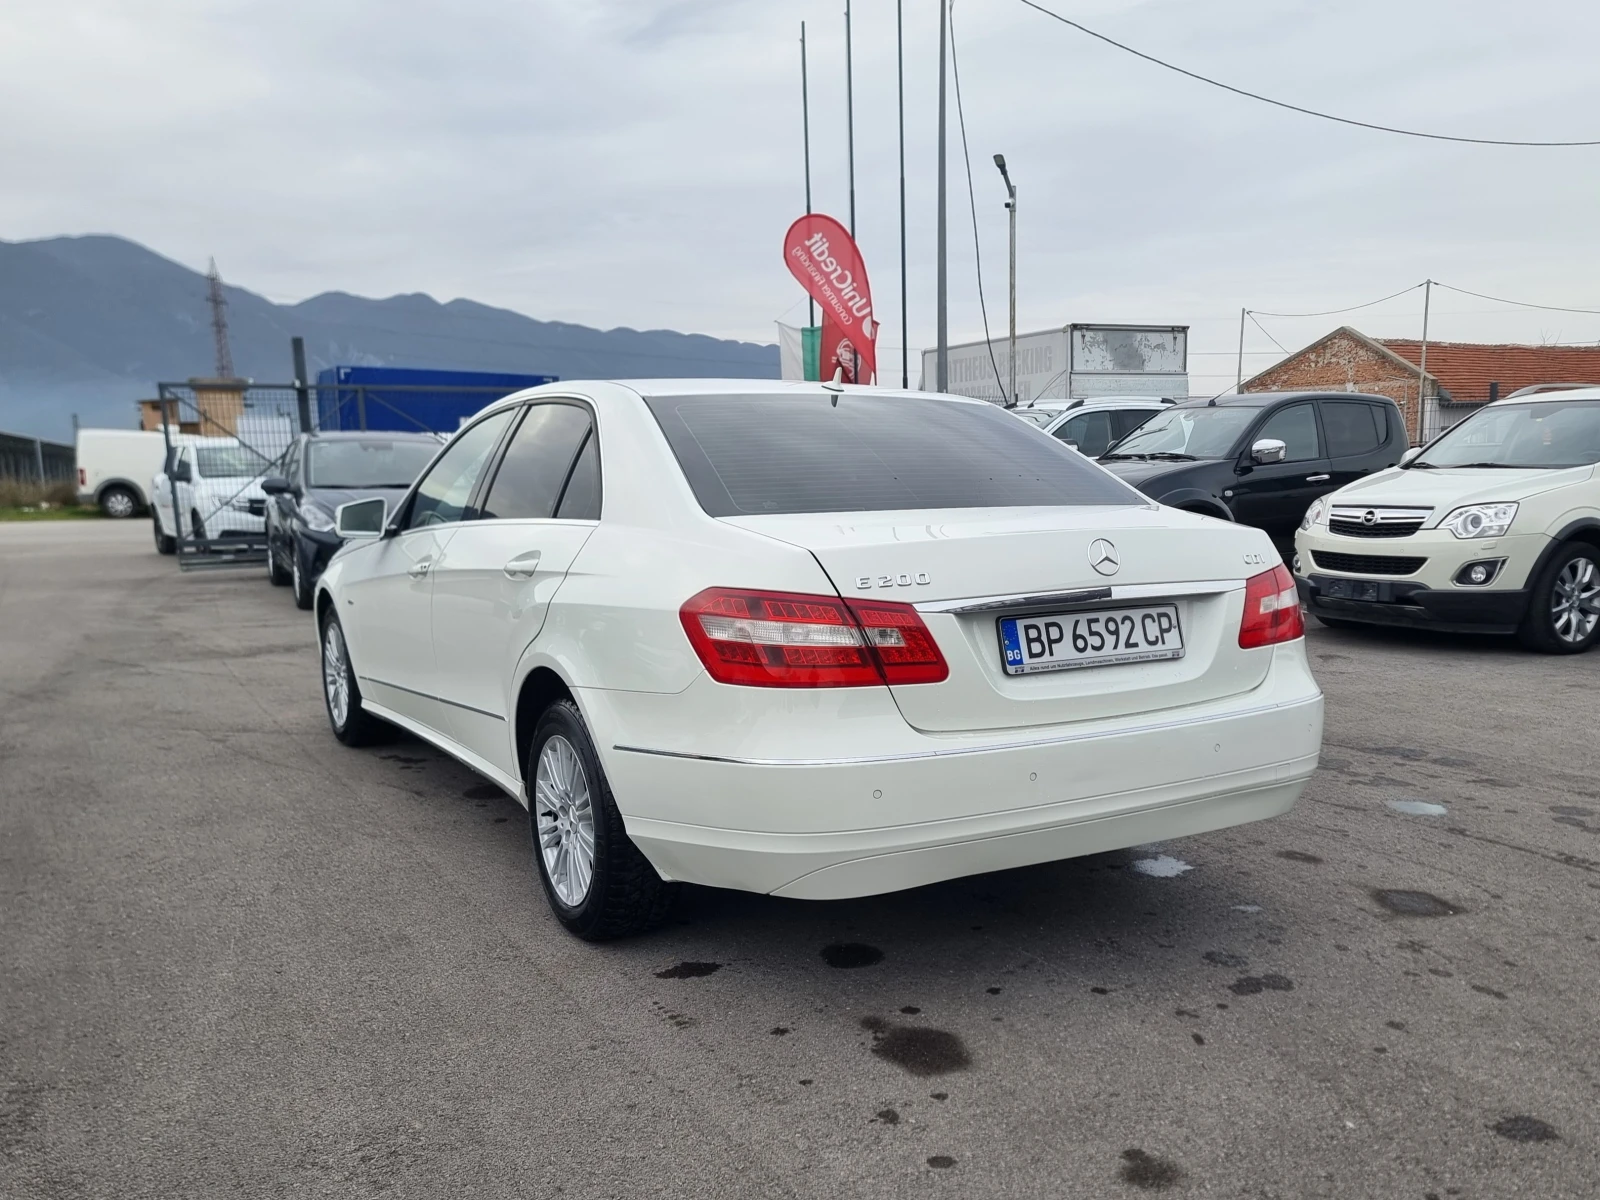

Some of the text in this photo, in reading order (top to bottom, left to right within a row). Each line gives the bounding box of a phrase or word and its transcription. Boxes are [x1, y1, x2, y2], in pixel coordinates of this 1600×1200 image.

[1243, 553, 1265, 565] CDI
[855, 572, 931, 590] E 200
[1023, 621, 1064, 659] BP
[1007, 649, 1021, 661] BG
